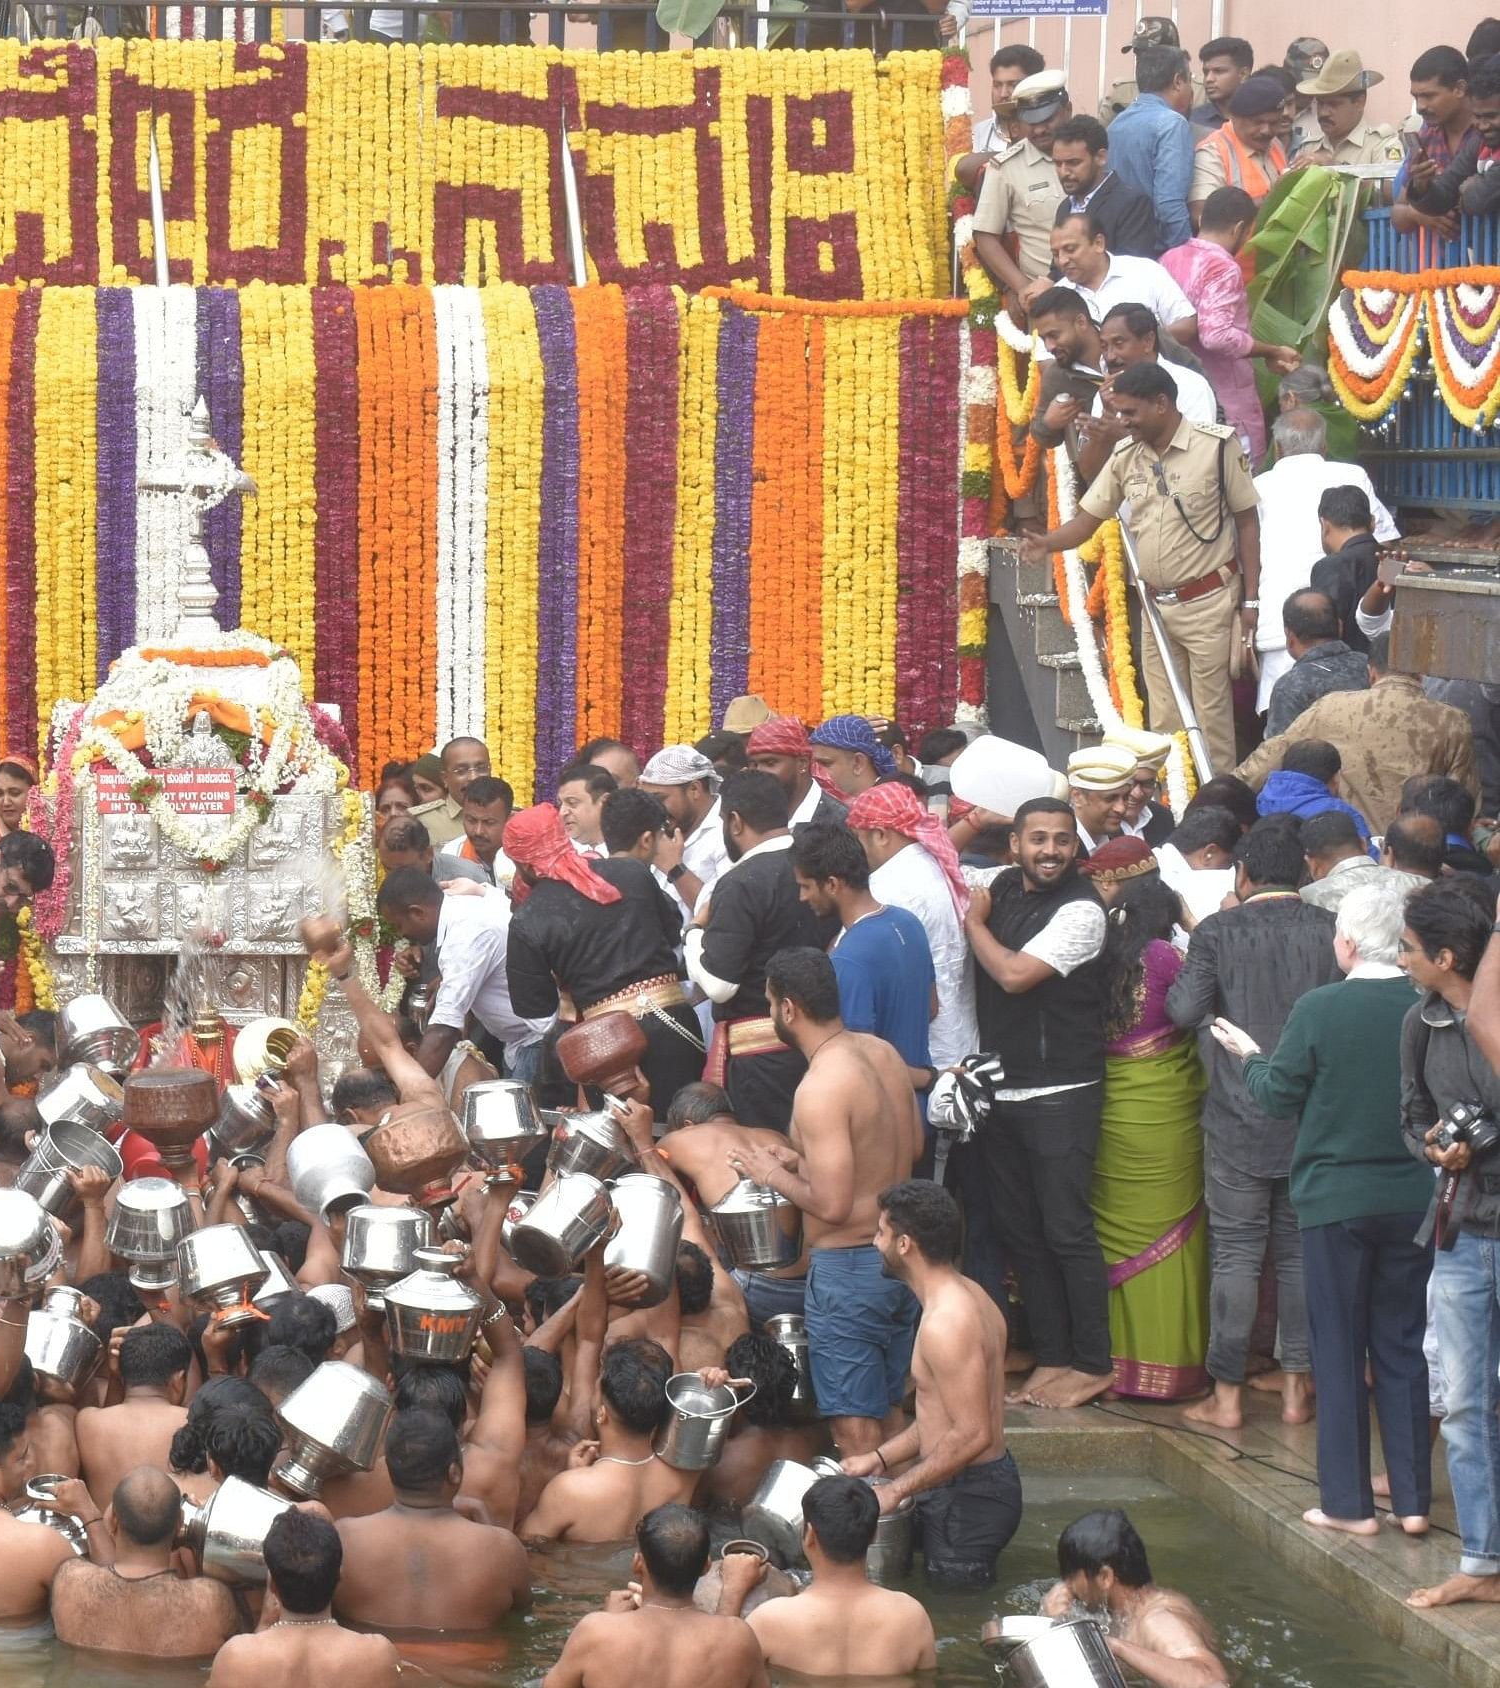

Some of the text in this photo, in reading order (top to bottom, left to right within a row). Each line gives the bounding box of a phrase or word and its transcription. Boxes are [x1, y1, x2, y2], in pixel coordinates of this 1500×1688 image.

[100, 793, 131, 802] PLEAS
[179, 791, 197, 801] PUT
[200, 791, 229, 800] COINS
[111, 803, 121, 811] IN
[125, 803, 137, 811] TO
[190, 802, 223, 811] WATER
[419, 1315, 468, 1333] KMT
